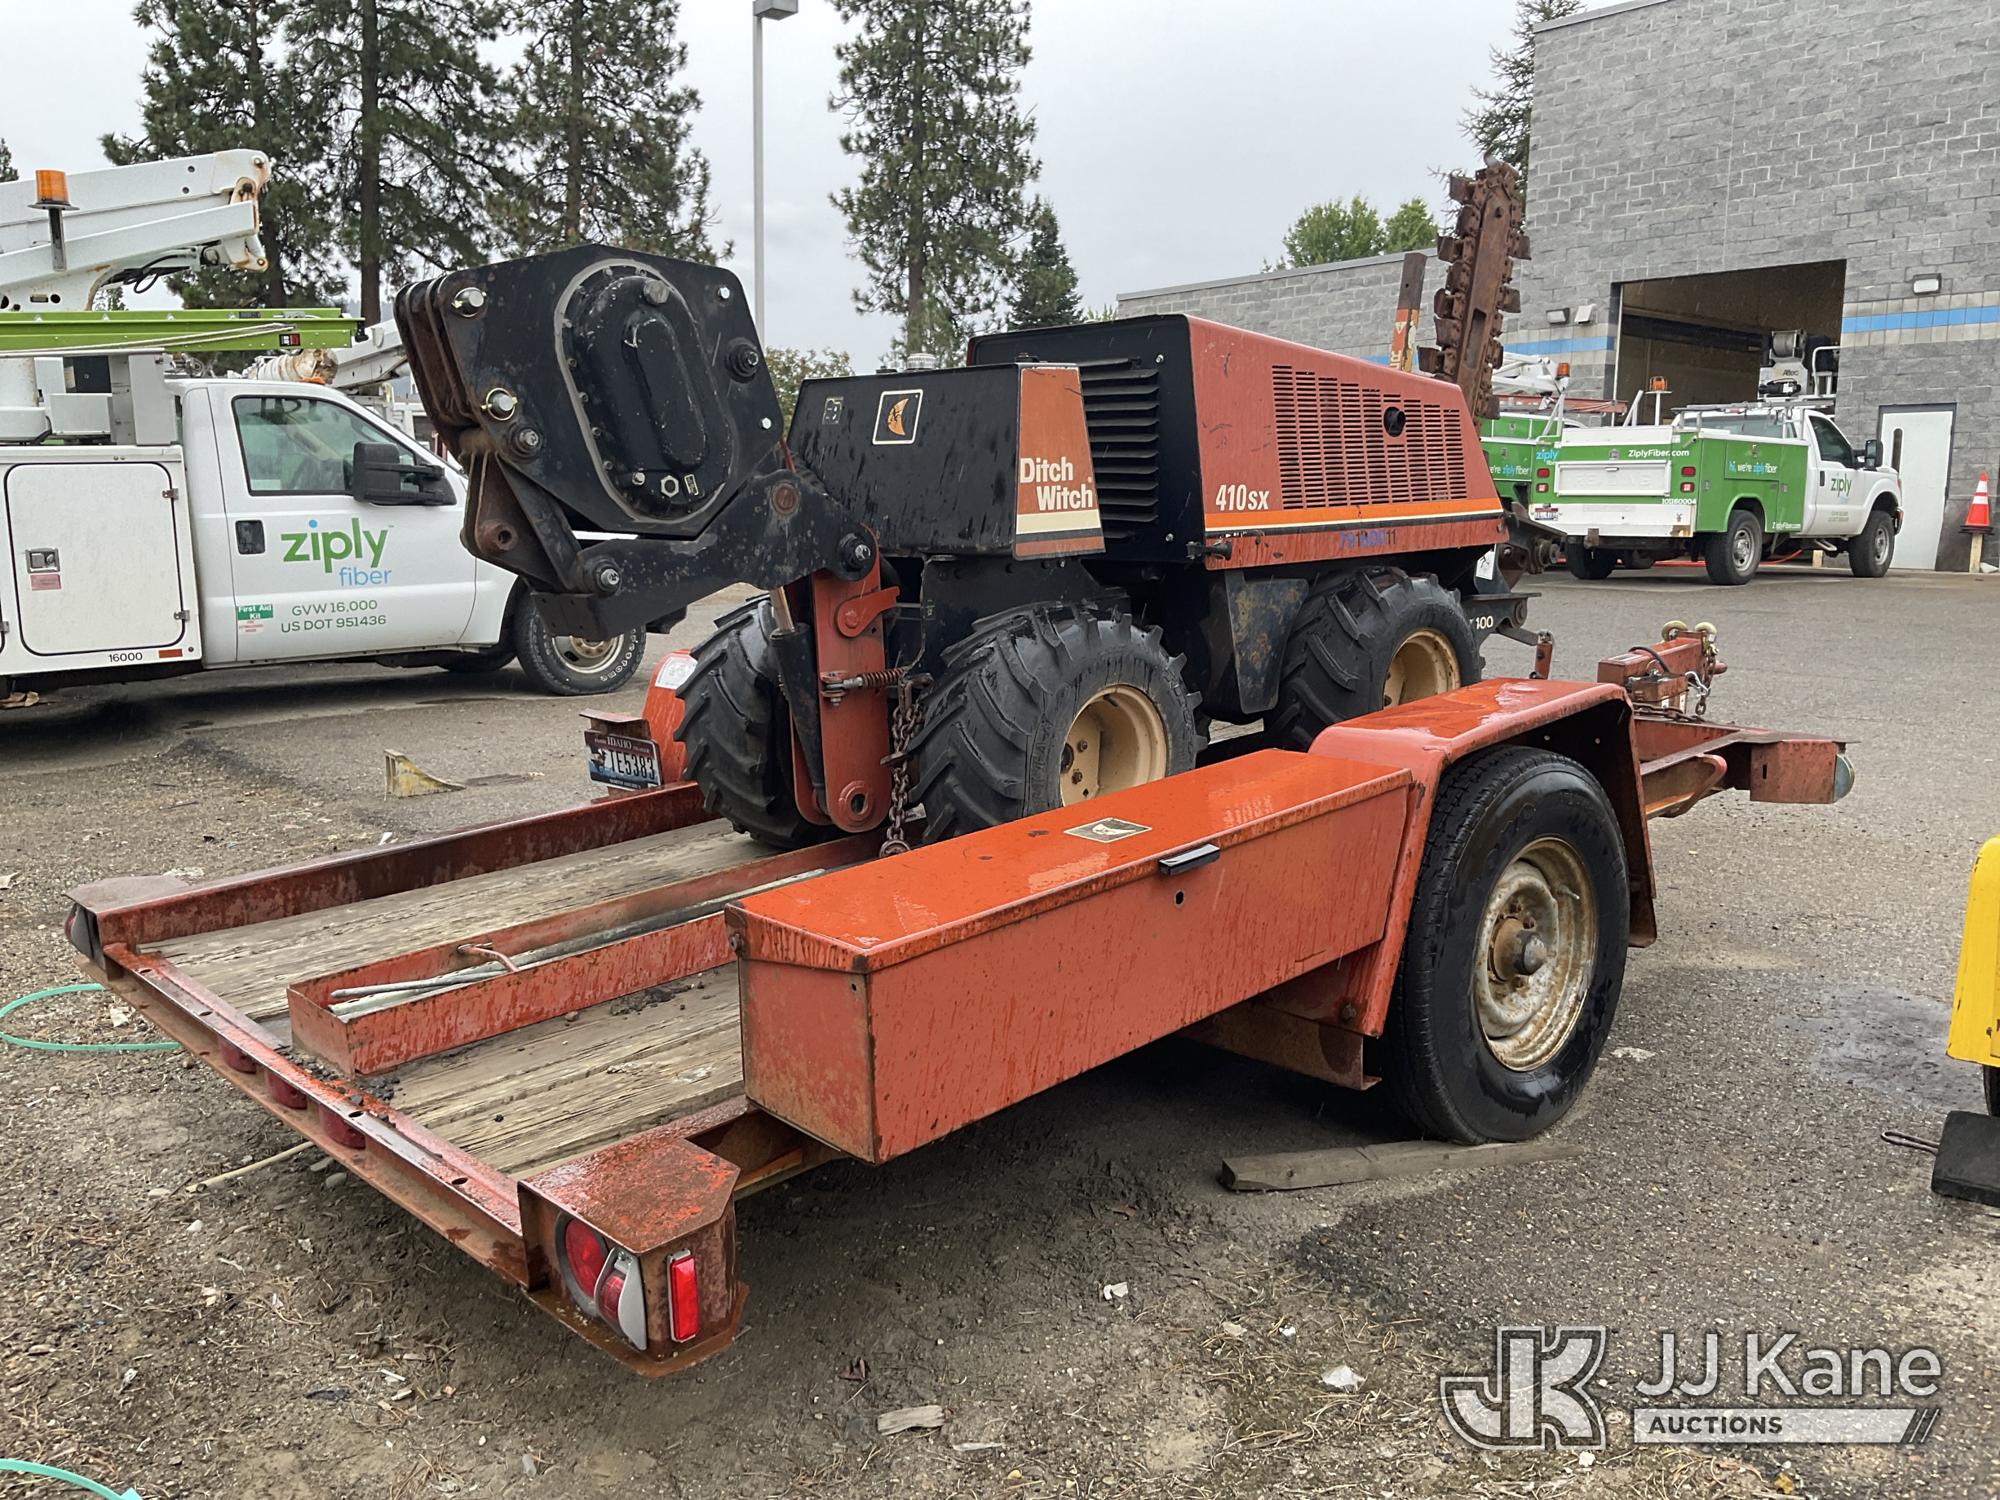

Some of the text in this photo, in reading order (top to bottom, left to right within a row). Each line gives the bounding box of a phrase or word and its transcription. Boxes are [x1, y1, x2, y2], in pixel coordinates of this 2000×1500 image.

[1020, 456, 1073, 483] Ditch
[1831, 472, 1852, 497] ziply
[1036, 483, 1093, 511] Witch
[281, 517, 389, 574] ziply
[338, 567, 392, 587] fiber
[292, 600, 378, 617] GVW 16,000
[281, 615, 387, 633] US DOT 951436
[1476, 615, 1494, 630] 100
[109, 652, 143, 663] 16000
